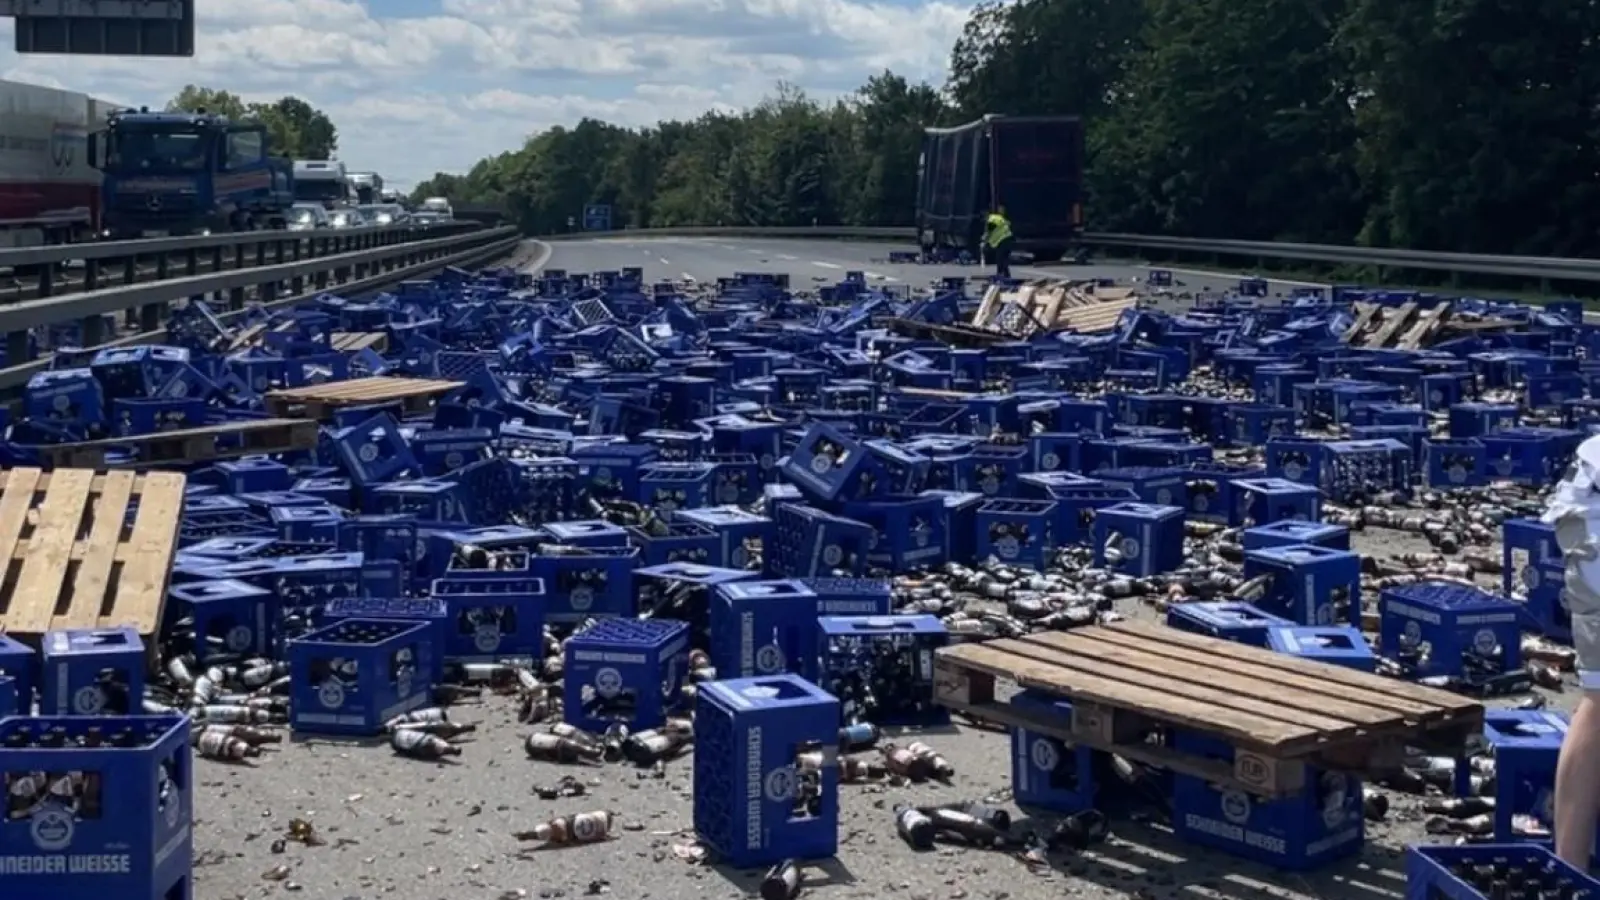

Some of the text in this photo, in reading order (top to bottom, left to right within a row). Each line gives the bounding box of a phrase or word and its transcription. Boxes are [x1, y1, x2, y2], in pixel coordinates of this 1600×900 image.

[748, 726, 761, 849] SCHNEIDER WEISSE
[69, 854, 130, 873] WEISSE
